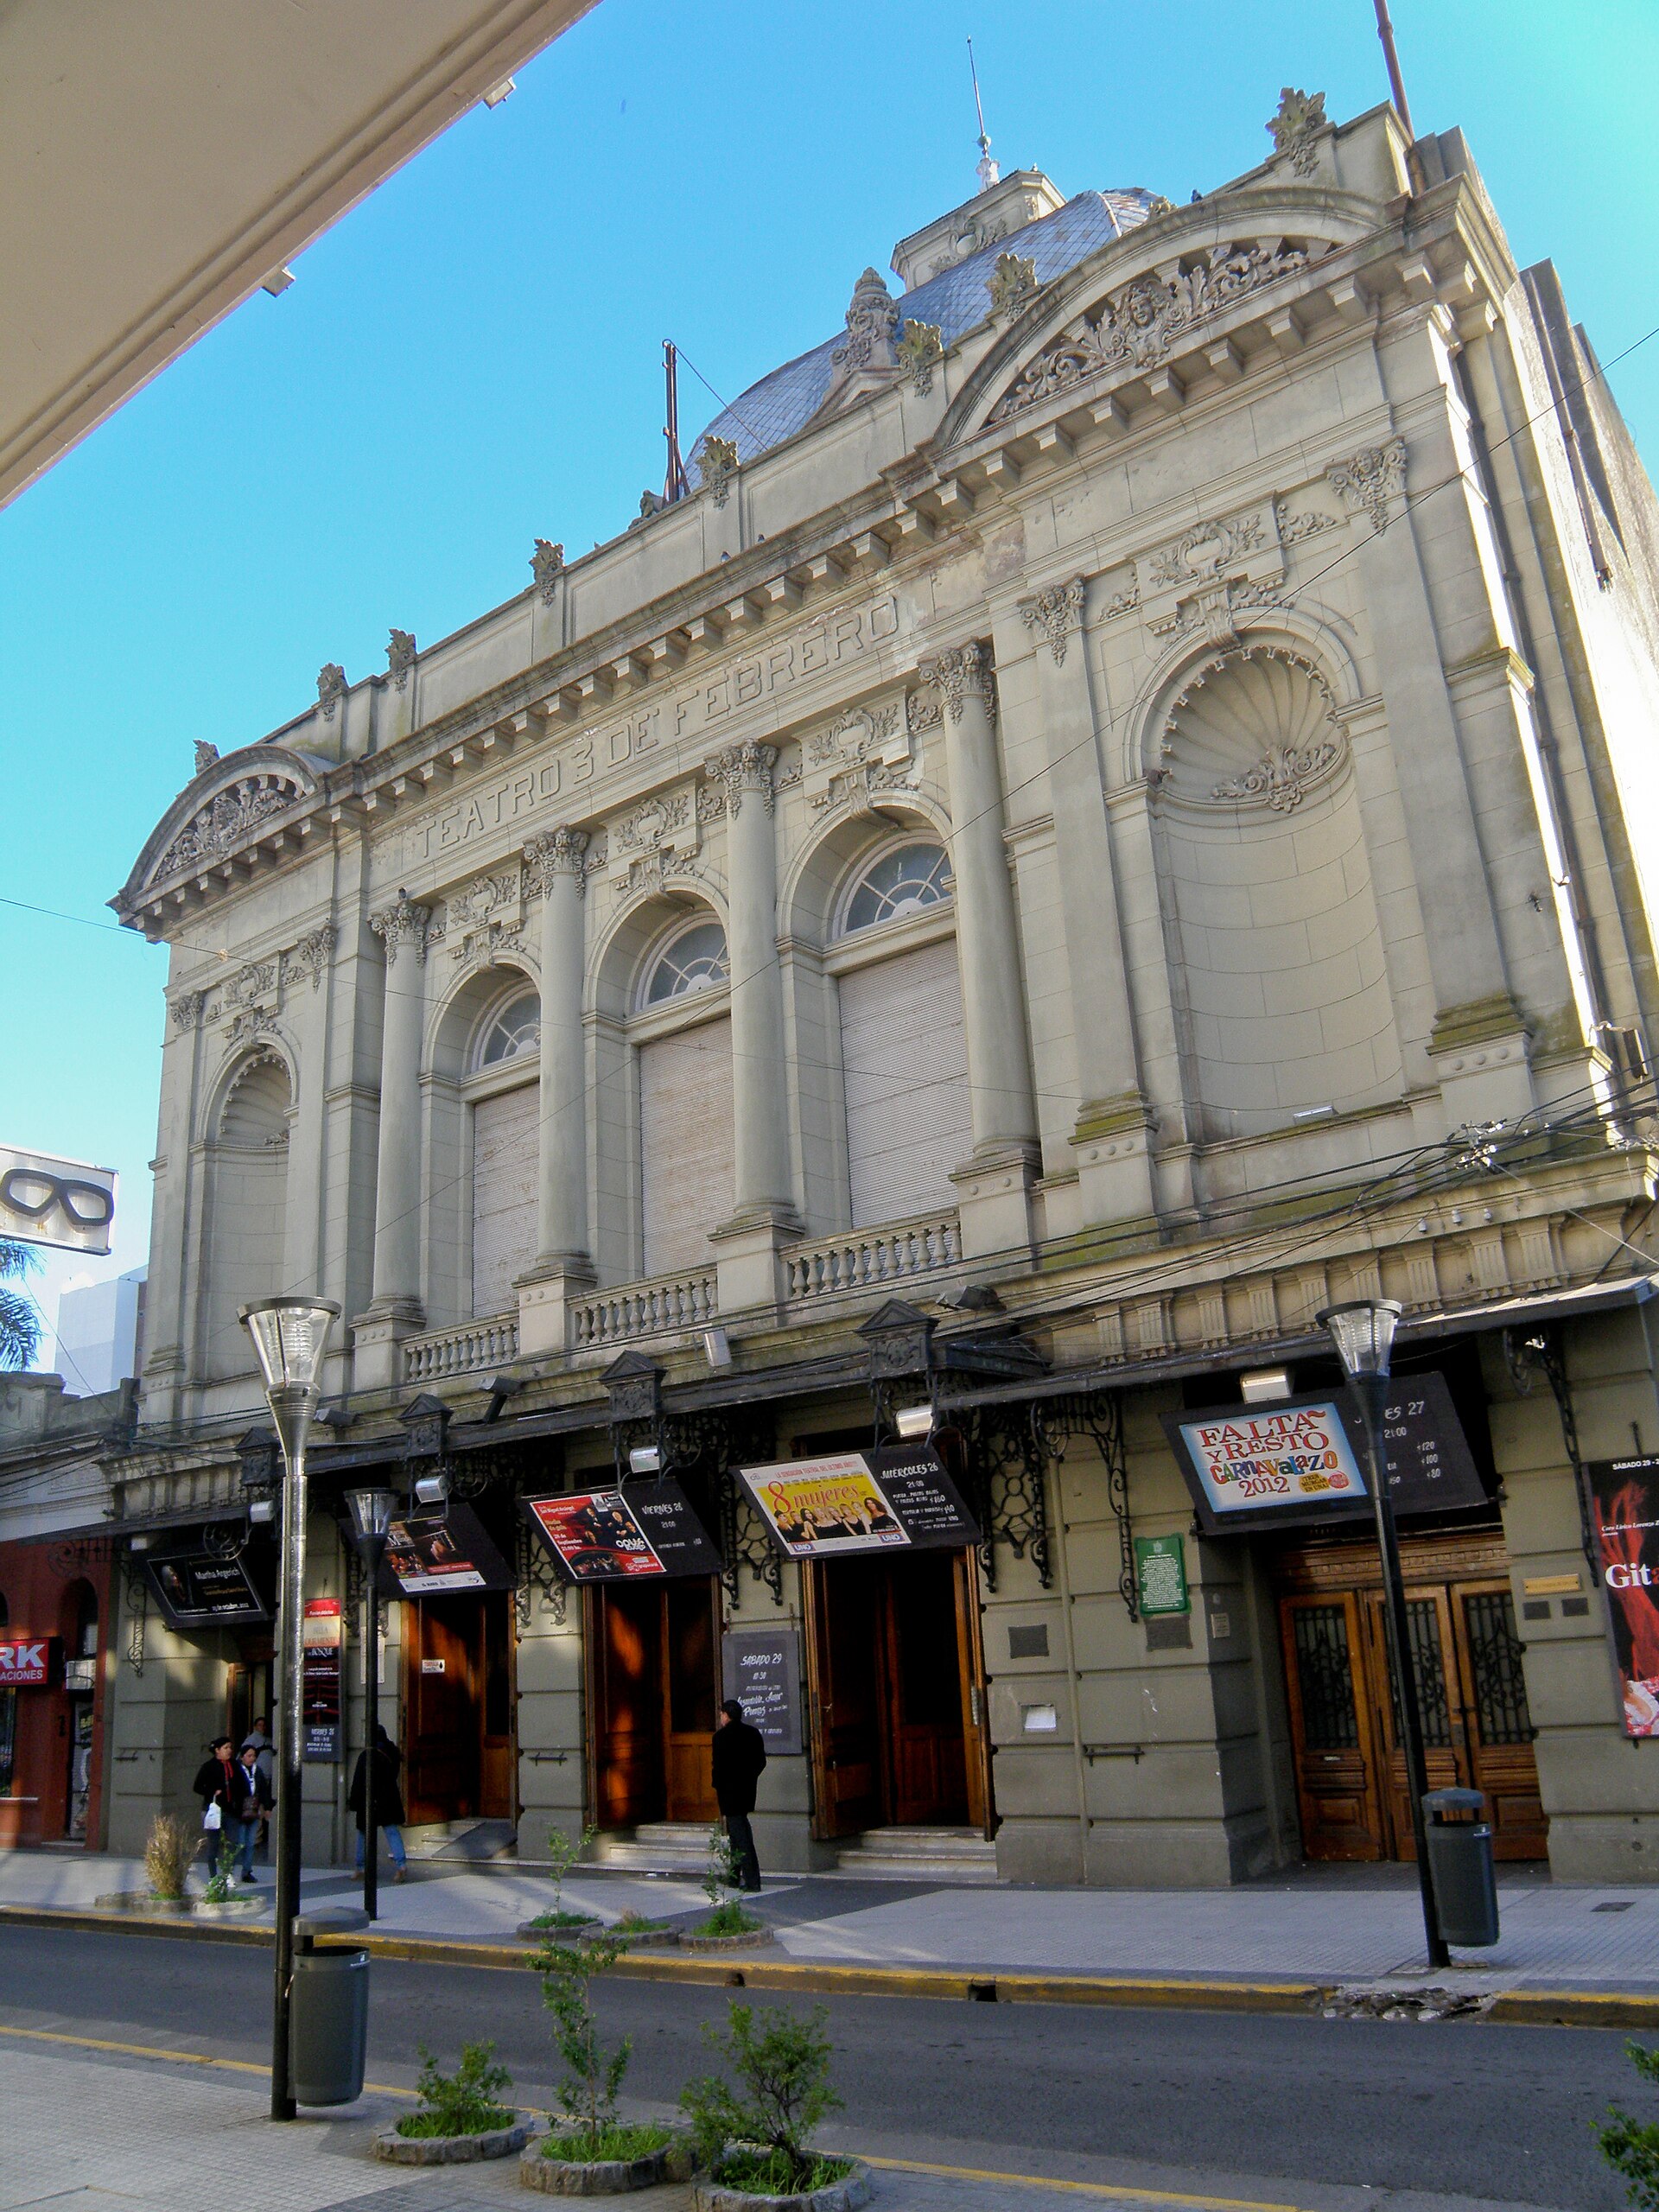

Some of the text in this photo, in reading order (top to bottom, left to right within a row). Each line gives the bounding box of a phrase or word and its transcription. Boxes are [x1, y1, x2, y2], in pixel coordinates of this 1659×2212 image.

[416, 595, 899, 858] TEATRO 3 DE FEBRERO
[1408, 1401, 1425, 1415] 27
[1197, 1412, 1320, 1447] FALTA
[1205, 1432, 1330, 1464] Y RESTO
[927, 1462, 939, 1472] 26
[768, 1480, 791, 1513] 8
[794, 1484, 859, 1507] mujeres
[1238, 1476, 1290, 1498] 2012
[642, 1503, 672, 1515] VIERNES
[772, 1653, 783, 1664] 29
